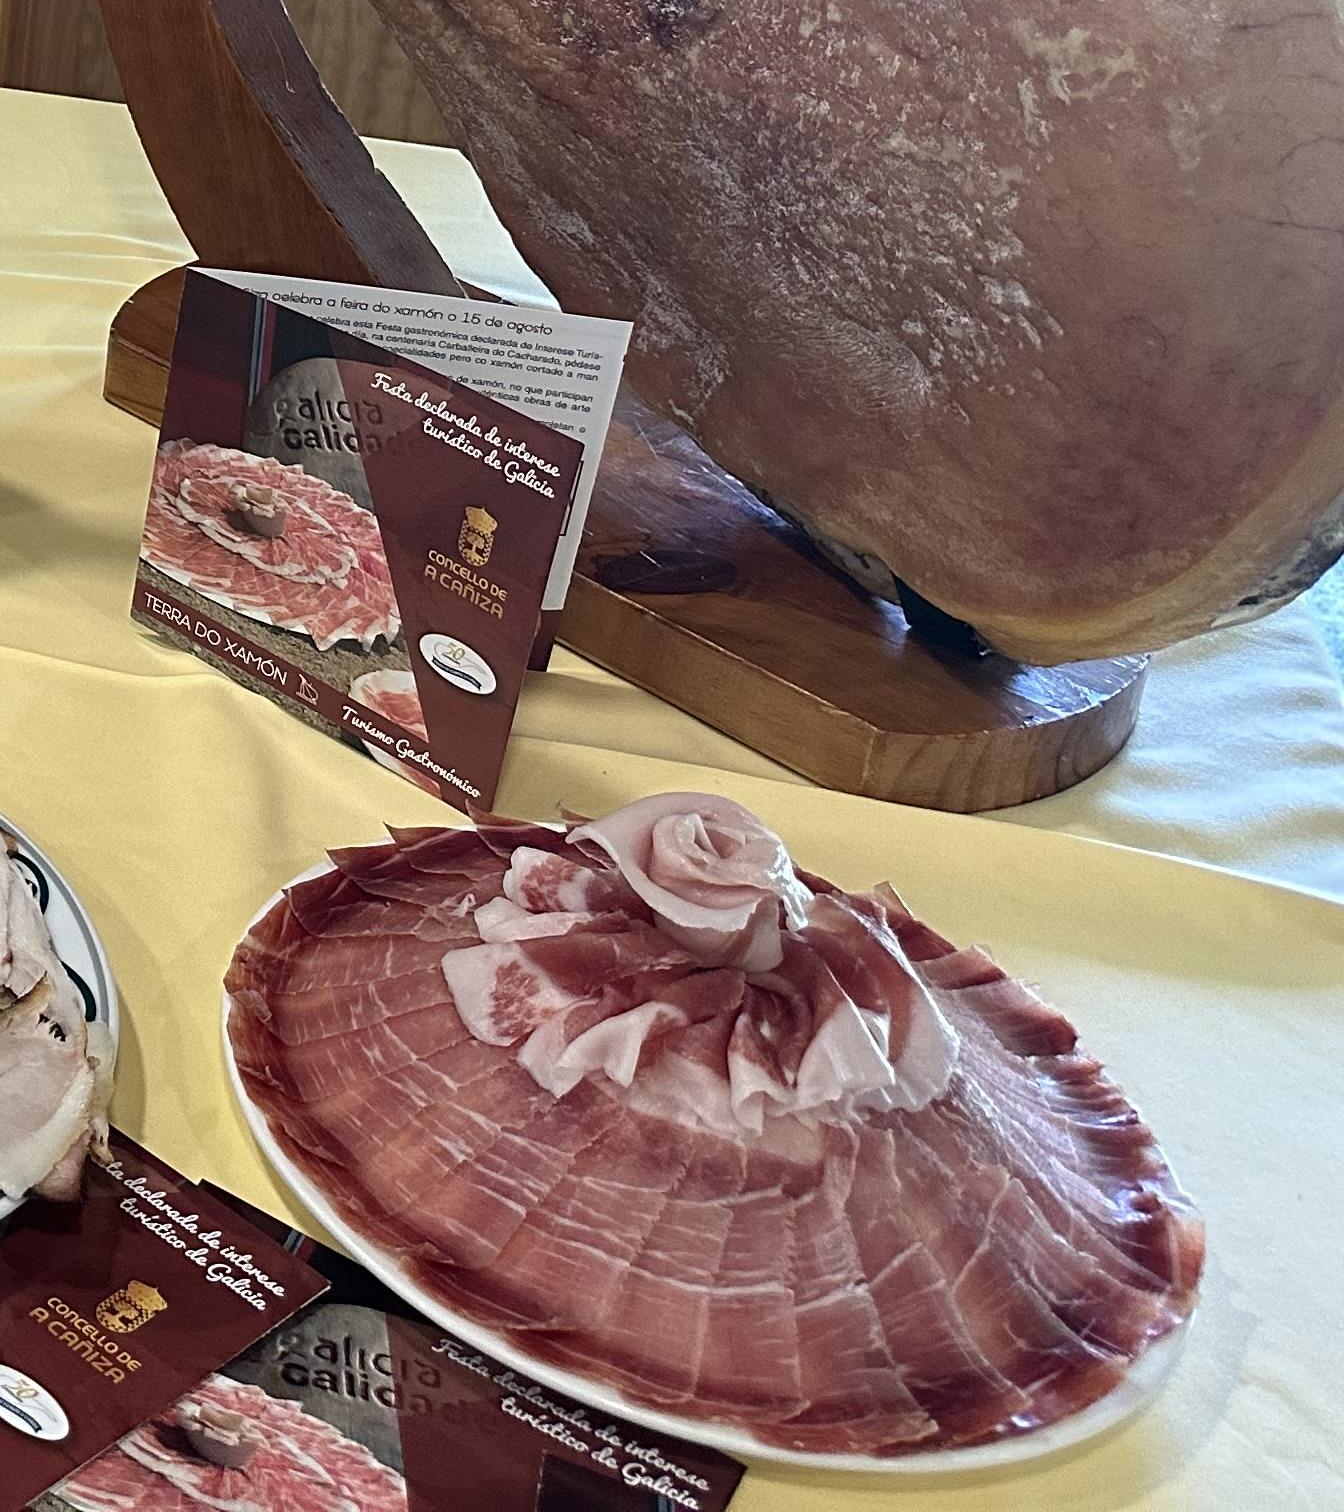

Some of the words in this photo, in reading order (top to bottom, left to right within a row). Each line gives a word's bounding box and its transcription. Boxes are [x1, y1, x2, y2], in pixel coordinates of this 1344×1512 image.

[272, 289, 323, 308] celebra
[326, 297, 337, 307] a
[340, 296, 369, 312] feira
[372, 300, 391, 314] do
[394, 303, 444, 321] xamón
[447, 312, 457, 322] o
[461, 312, 481, 326] 15
[483, 314, 503, 329] de
[506, 318, 553, 337] agosto
[471, 334, 518, 348] declarada
[520, 341, 533, 350] de
[438, 340, 490, 355] Carballeira
[492, 347, 505, 356] do
[507, 350, 561, 366] Cacharado,
[490, 358, 523, 370] xamón
[526, 364, 563, 376] cortado
[369, 371, 414, 406] Festa
[414, 392, 483, 437] declarada
[481, 422, 502, 447] de
[503, 436, 561, 478] interese
[524, 395, 551, 407] obras
[545, 389, 593, 402] participan
[422, 418, 483, 460] turístico
[483, 447, 502, 470] de
[502, 460, 556, 500] Galicia
[424, 565, 439, 583] A
[439, 571, 504, 620] CAÑIZA
[427, 548, 484, 589] CONCELLO
[485, 579, 508, 602] DE
[144, 590, 191, 632] TERRA
[193, 620, 221, 647] DO
[221, 635, 288, 687] XAMÓN
[342, 704, 395, 746] Turismo
[394, 738, 482, 799] Gastronómico
[118, 1196, 187, 1255] turístico
[204, 1261, 267, 1313] Galicia
[121, 1172, 201, 1237] declarada
[200, 1223, 221, 1250] de
[219, 1242, 288, 1299] interese
[45, 1296, 105, 1351] CONCELLO
[102, 1341, 141, 1373] DE
[45, 1317, 127, 1386] CAÑIZA
